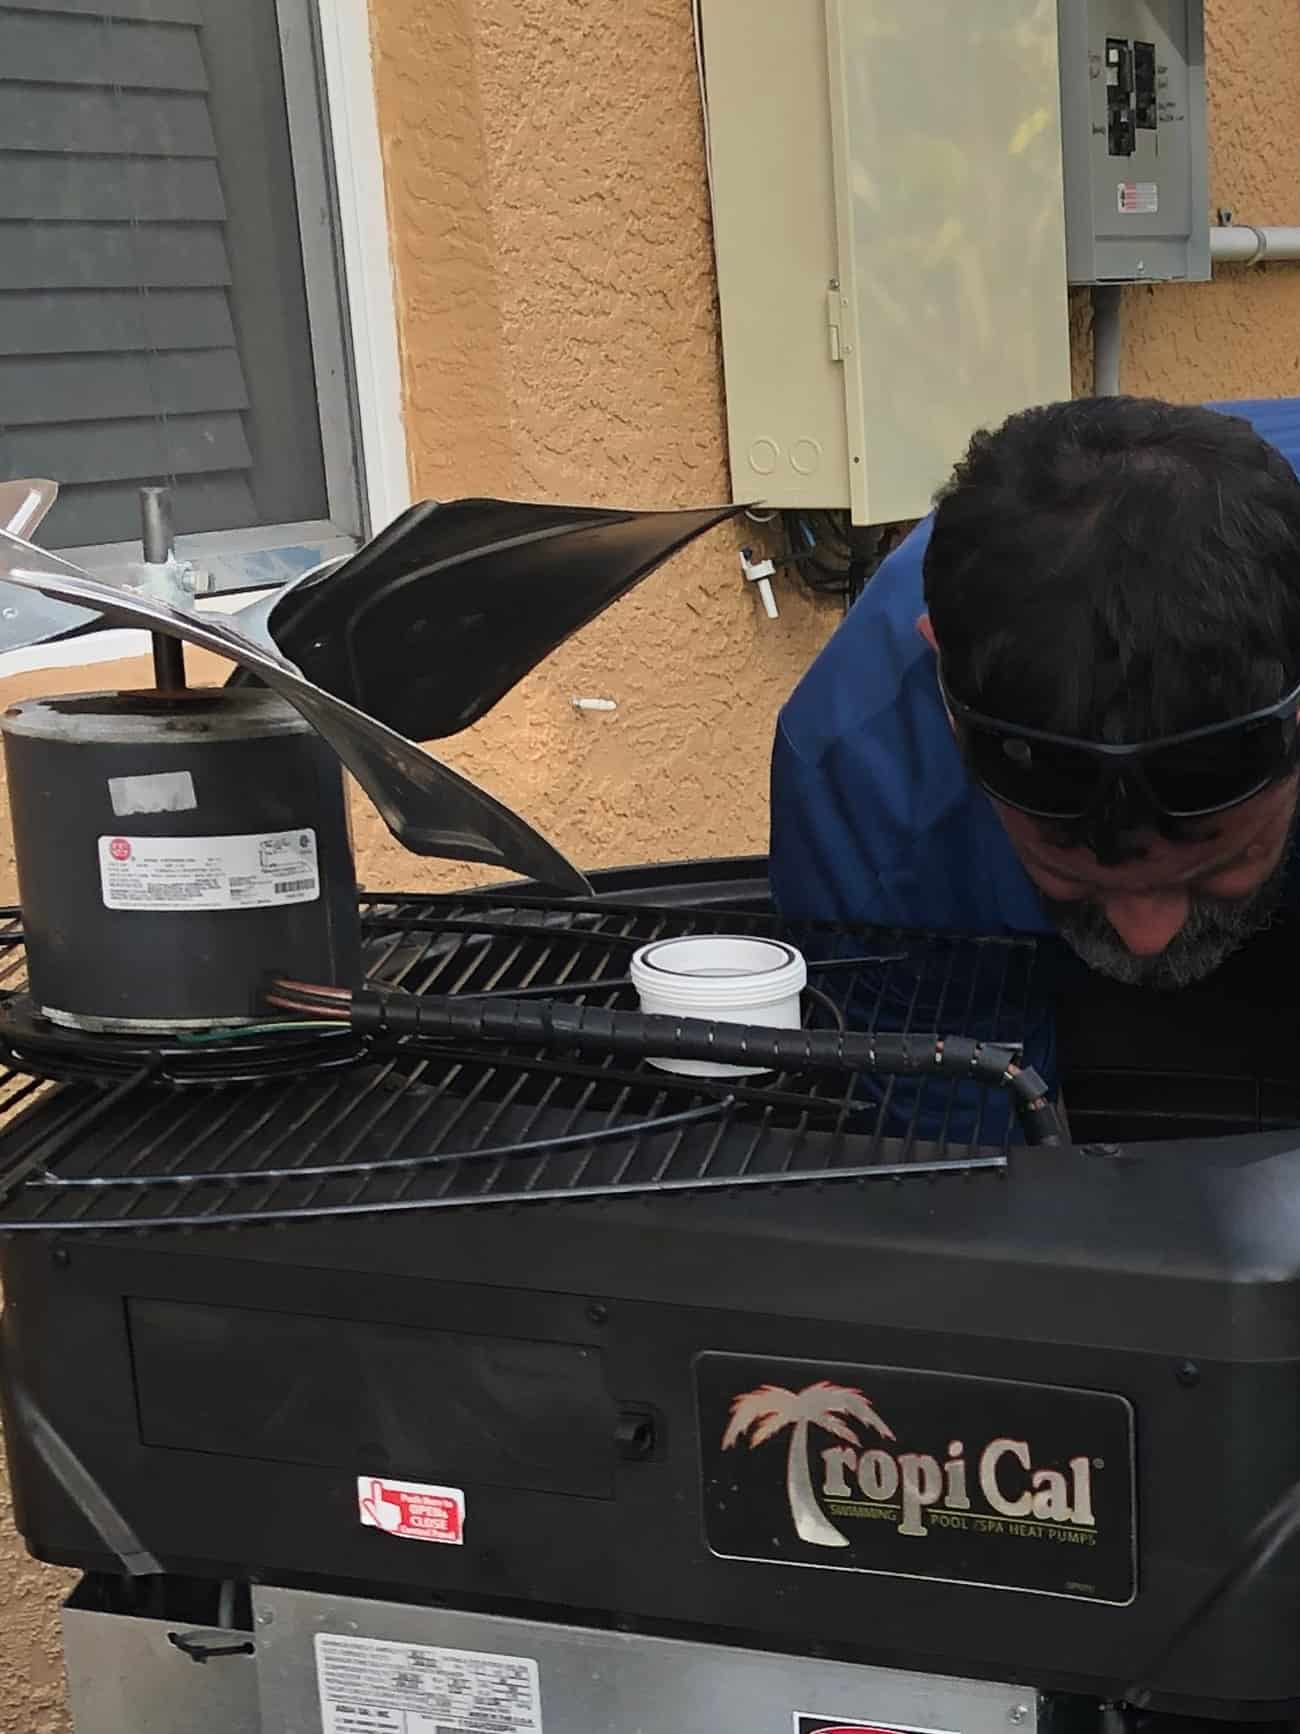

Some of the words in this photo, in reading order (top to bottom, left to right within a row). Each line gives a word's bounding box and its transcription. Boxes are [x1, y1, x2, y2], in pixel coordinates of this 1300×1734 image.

[409, 1516, 449, 1531] CLOSE
[929, 1513, 970, 1530] POOL
[1008, 1524, 1045, 1540] HEAT
[1048, 1528, 1097, 1546] PUMPS
